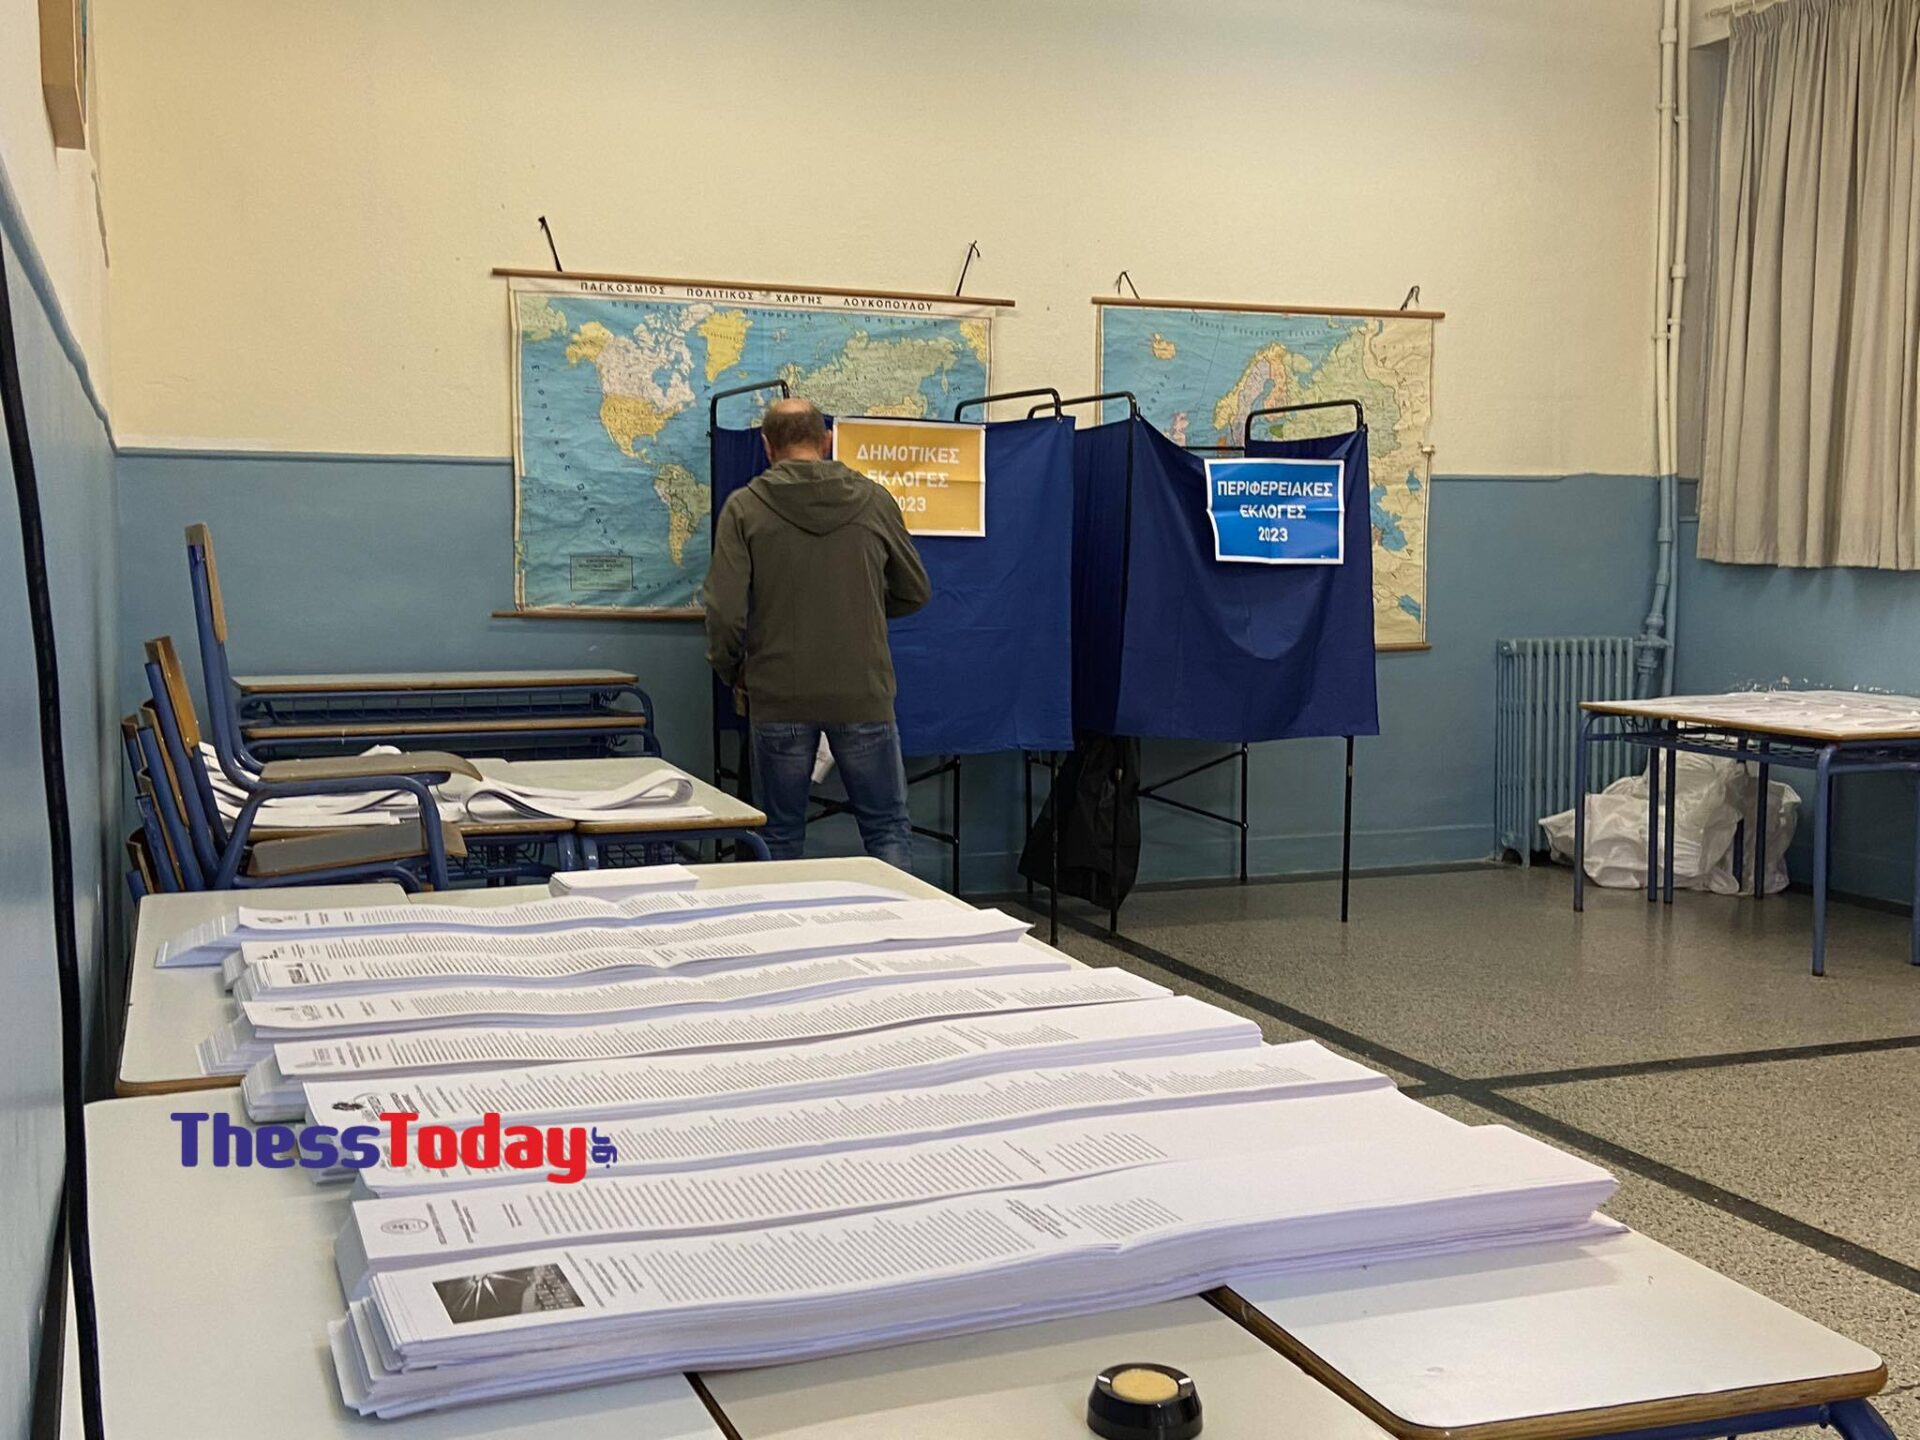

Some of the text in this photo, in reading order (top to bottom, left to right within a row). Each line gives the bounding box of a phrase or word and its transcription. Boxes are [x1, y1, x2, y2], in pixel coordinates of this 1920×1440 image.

[580, 281, 933, 312] ΠΑΓΚΟΣΜΙΟΣ ΠΟΛΙΤΙΚΟΣ ΧΑΡΤΗΣ ΛΟΥΚΟΠΟΥΛΟΥ
[856, 444, 960, 465] ΔΗΜΟΤΙΚΕΣ
[867, 469, 949, 488] ΕΚΛΟΓΕΣ
[1217, 480, 1333, 498] ΠΕΡΙΦΕΡΕΙΑΚΕΣ
[1239, 504, 1307, 519] ΕΚΛΟΓΕΣ
[1258, 526, 1288, 542] 2023
